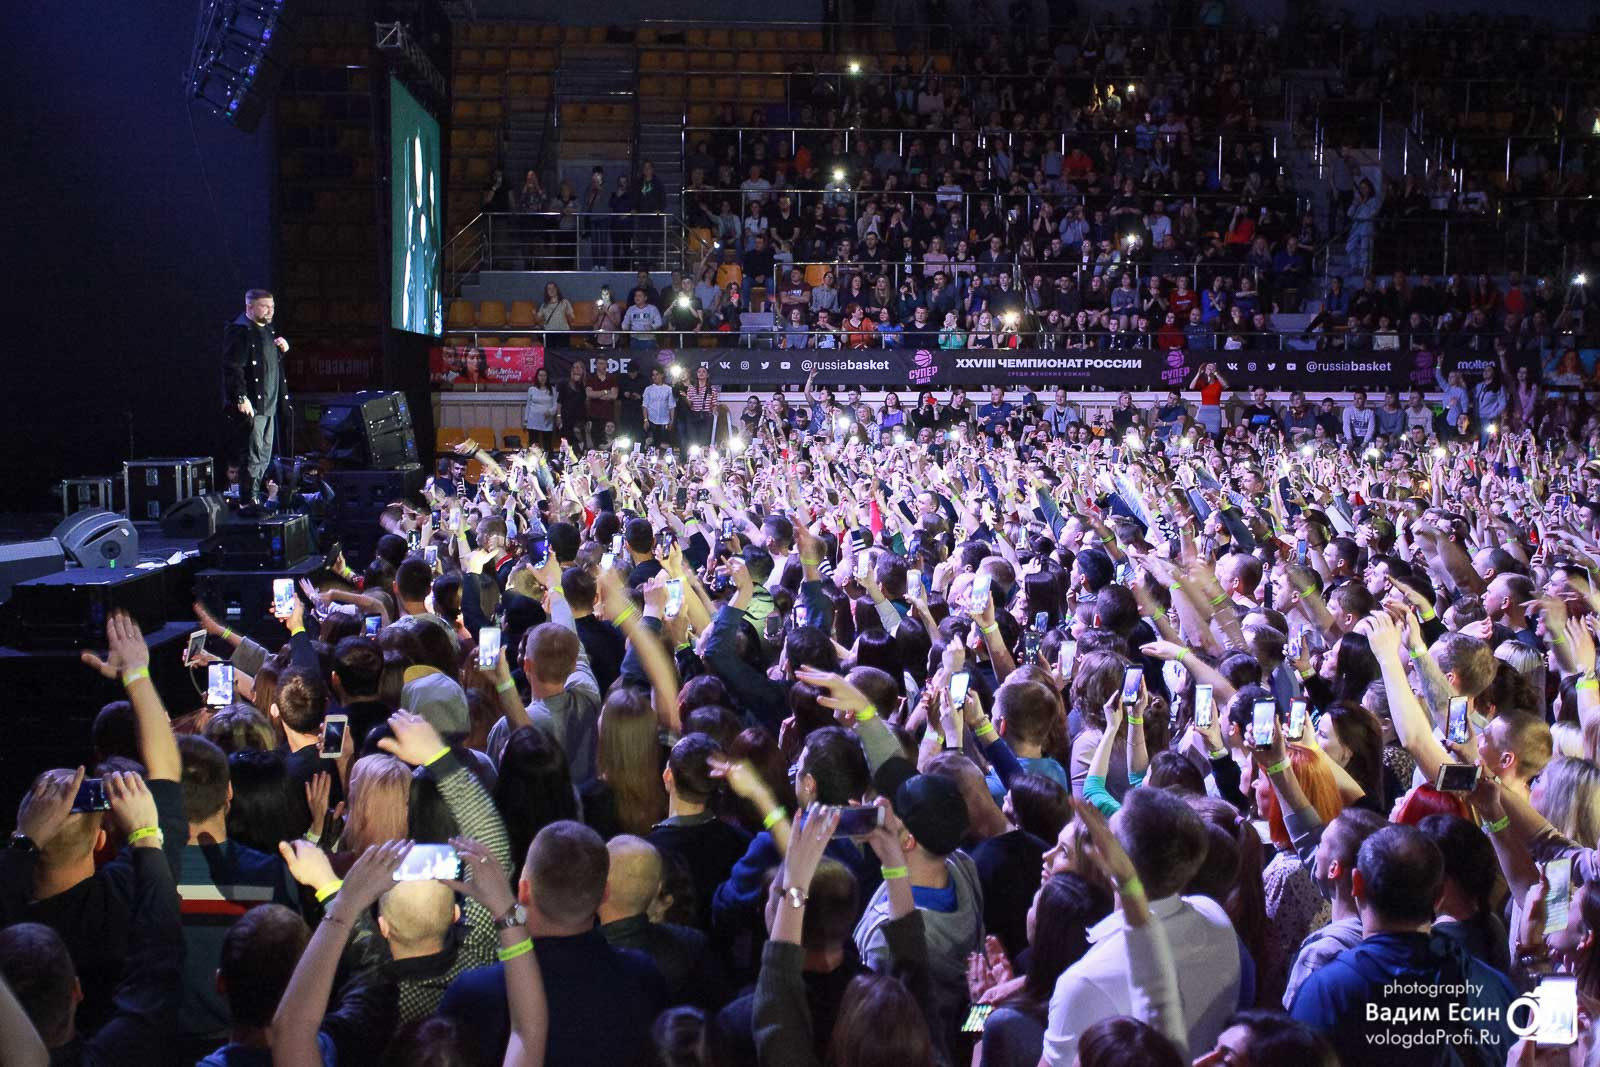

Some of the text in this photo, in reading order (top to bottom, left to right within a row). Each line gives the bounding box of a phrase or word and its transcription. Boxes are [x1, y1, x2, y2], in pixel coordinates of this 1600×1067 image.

[801, 359, 890, 372] @russiabasket
[955, 358, 1142, 369] XXVIII ЧЕМПИОНАТ РОССИИ
[1306, 361, 1392, 373] @russiabasket
[908, 366, 938, 380] СУПЕР
[1161, 367, 1190, 380] СУПЕР
